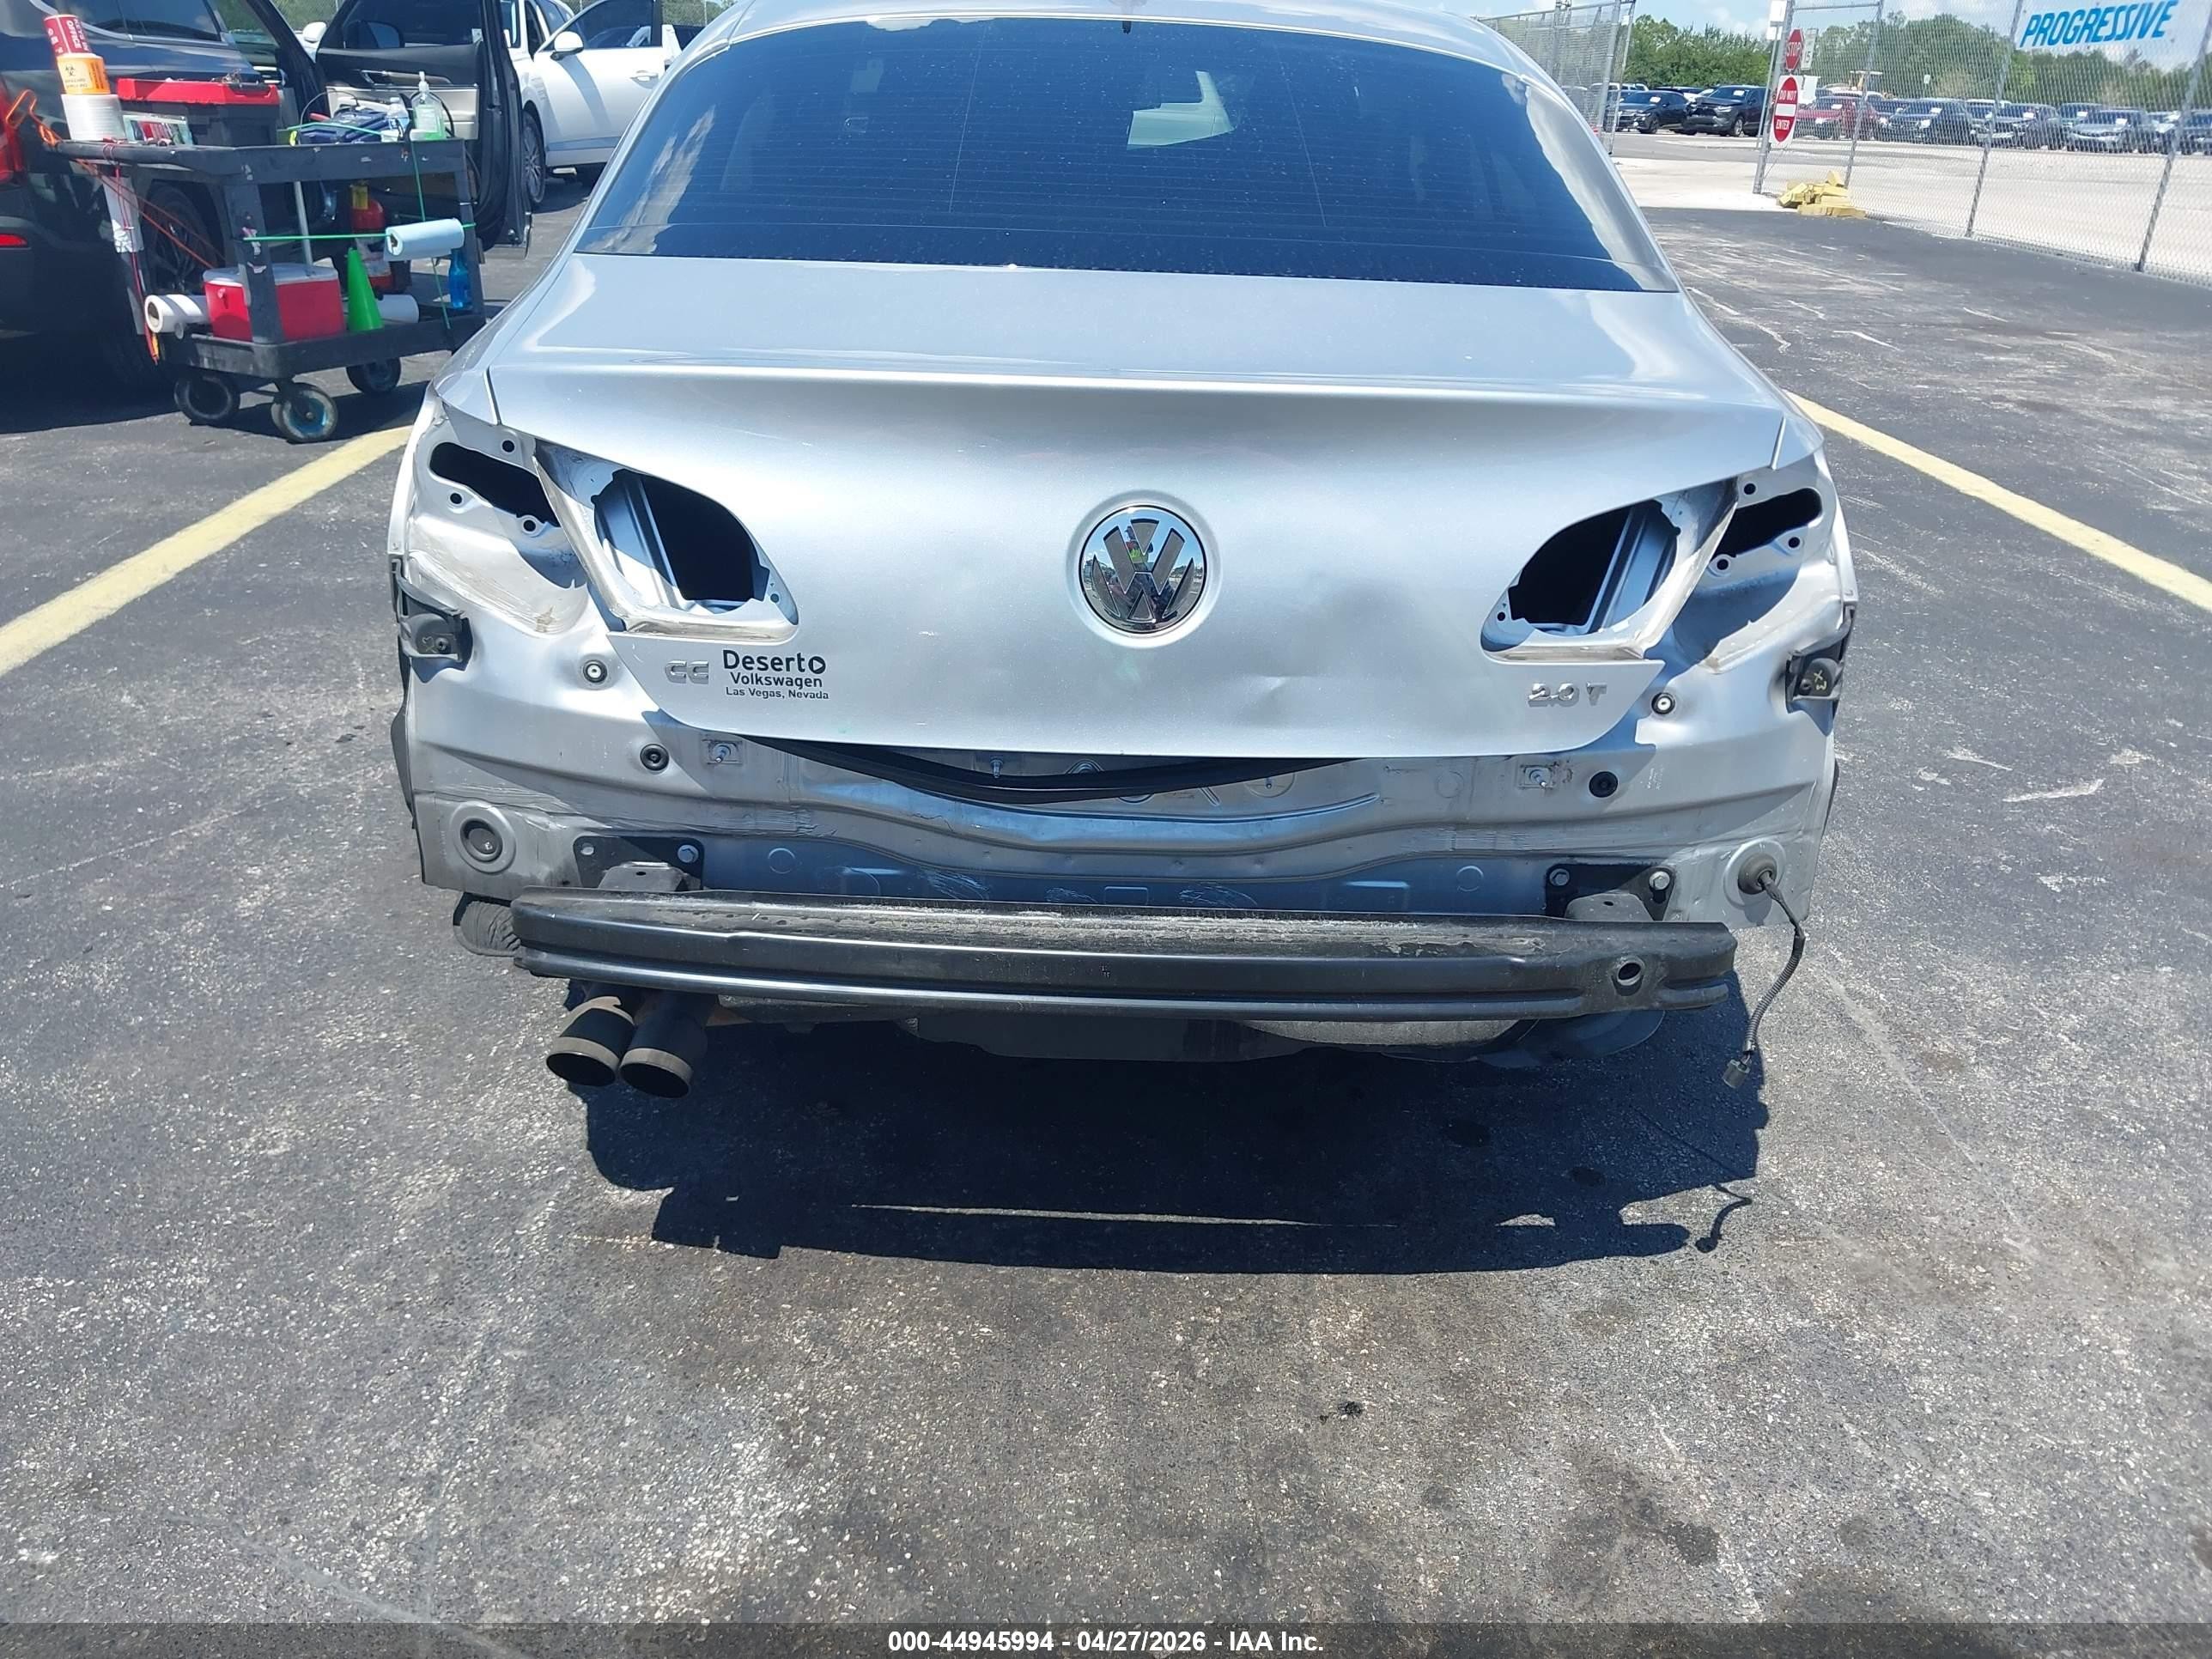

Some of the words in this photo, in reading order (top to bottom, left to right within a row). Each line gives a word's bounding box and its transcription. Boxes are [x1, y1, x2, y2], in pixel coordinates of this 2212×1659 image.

[2020, 0, 2179, 48] PROGRESSIVE
[66, 20, 82, 49] OFFICE
[1786, 41, 1802, 57] STOP
[1778, 89, 1786, 100] DO
[1787, 89, 1797, 101] NOT
[1776, 118, 1790, 130] ENTER
[665, 660, 709, 684] CC
[730, 672, 823, 690] Volkswagen
[726, 687, 745, 696] Las
[748, 688, 785, 700] Vegas,
[788, 690, 829, 700] Nevada
